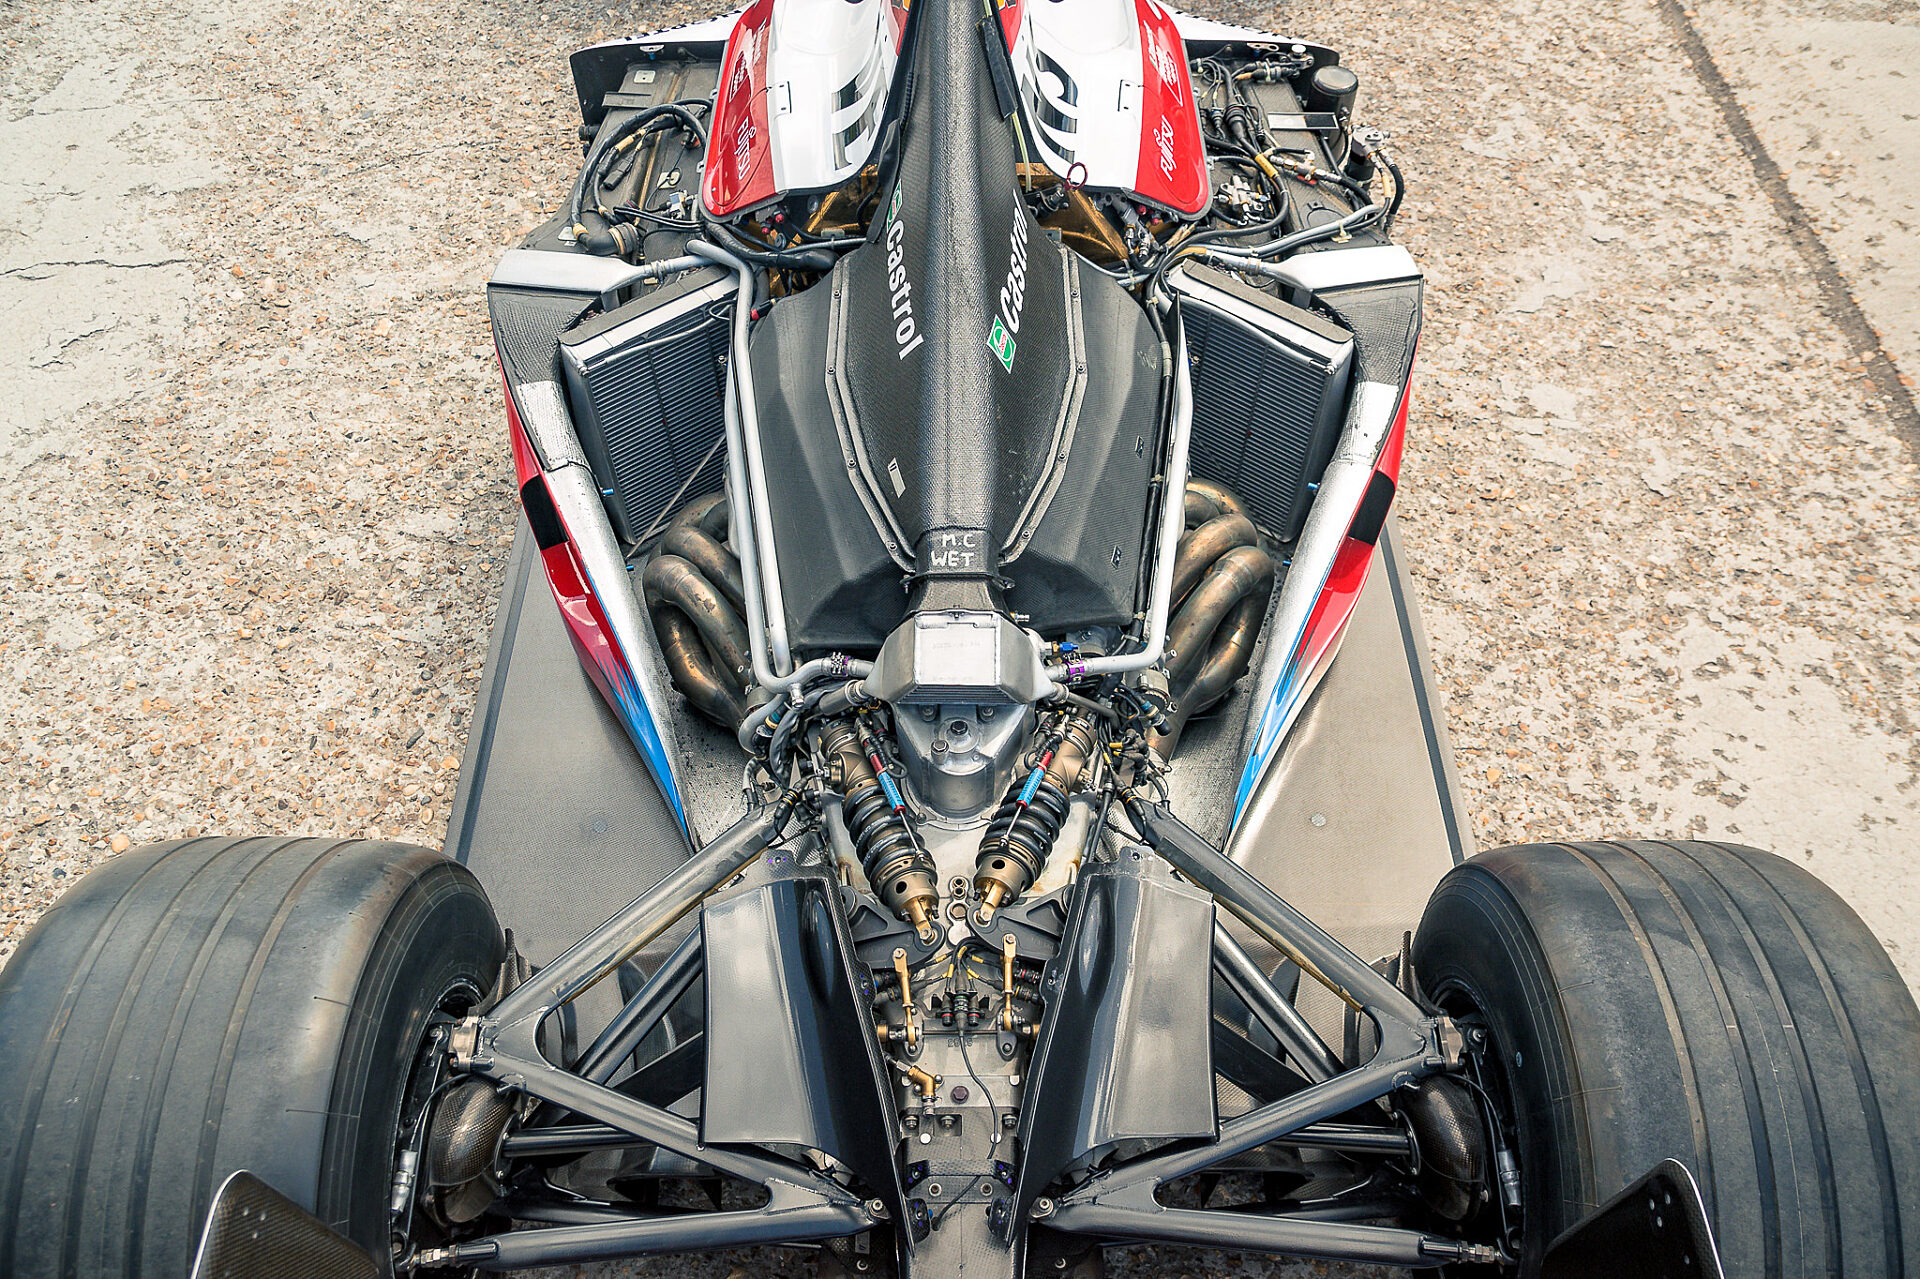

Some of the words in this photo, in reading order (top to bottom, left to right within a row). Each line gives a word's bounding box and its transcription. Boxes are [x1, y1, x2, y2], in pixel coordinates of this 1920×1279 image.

[886, 219, 924, 361] Castrol
[1000, 188, 1028, 334] Castrol
[930, 551, 975, 567] WET
